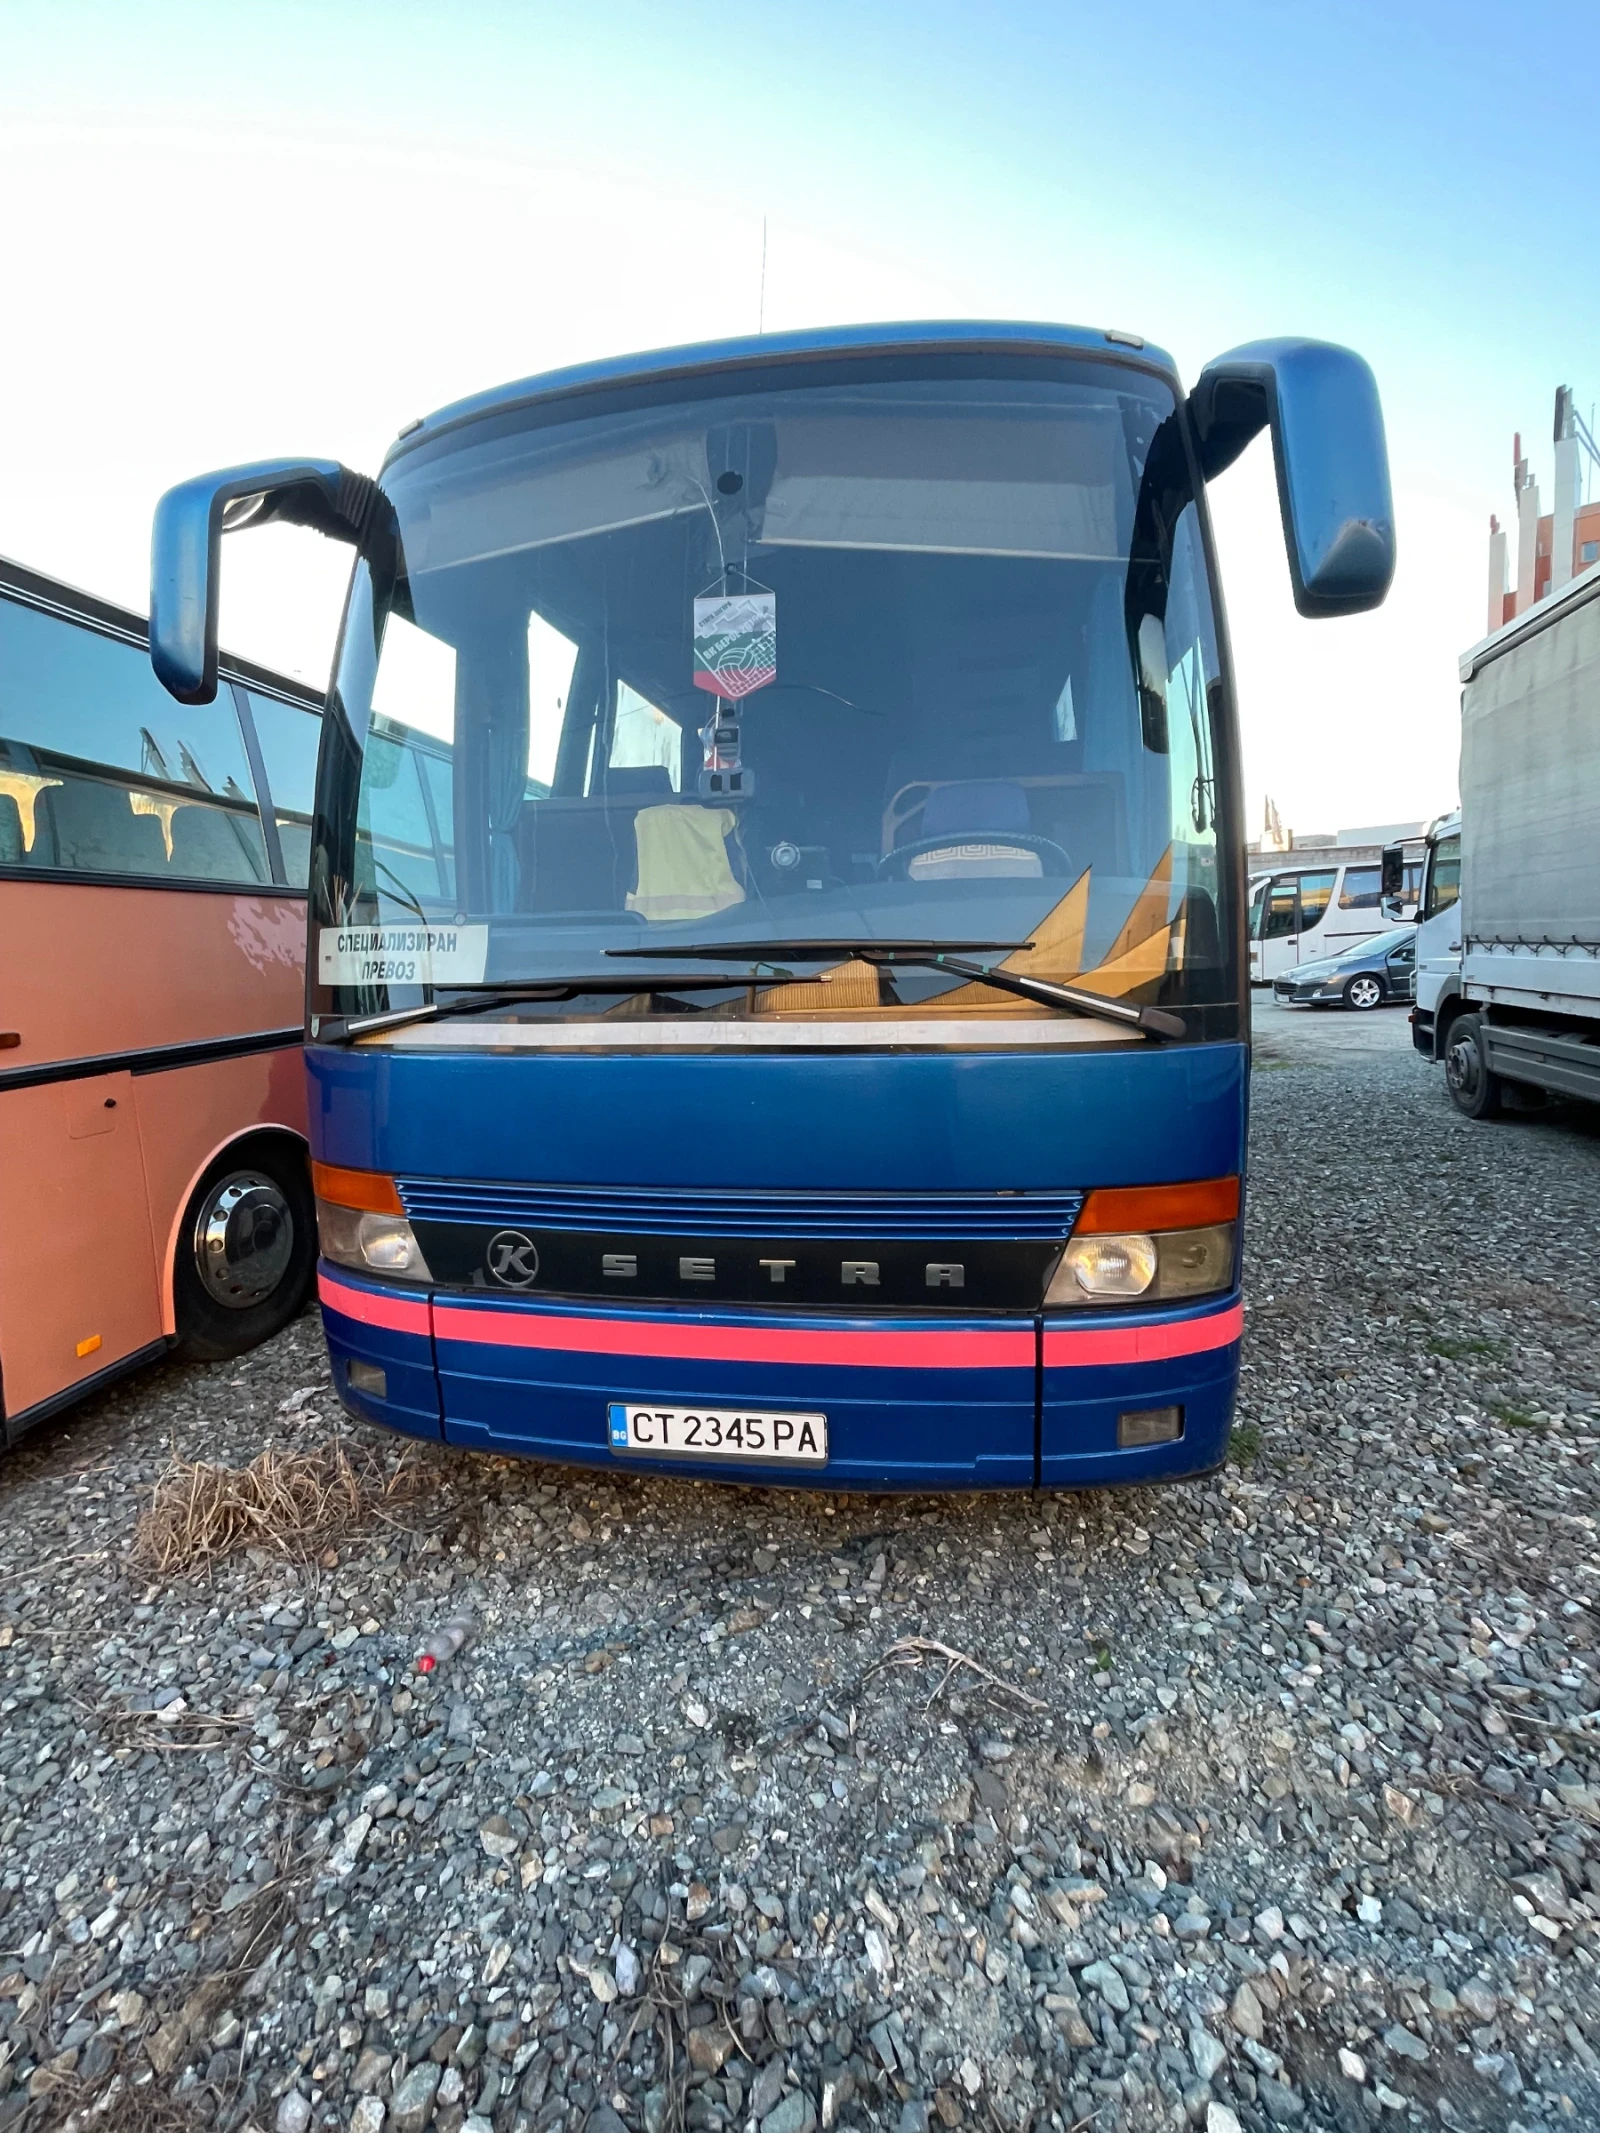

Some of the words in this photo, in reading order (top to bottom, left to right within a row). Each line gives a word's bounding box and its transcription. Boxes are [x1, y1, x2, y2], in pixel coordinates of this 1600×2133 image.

[337, 932, 457, 955] СПЕЦИАЛИЗИРАН
[361, 960, 416, 981] ПРЕВОЗ
[602, 1253, 966, 1288] SETRA
[612, 1430, 627, 1440] BG
[632, 1412, 675, 1444] CT
[683, 1415, 766, 1449] 2345
[773, 1419, 818, 1452] PA
